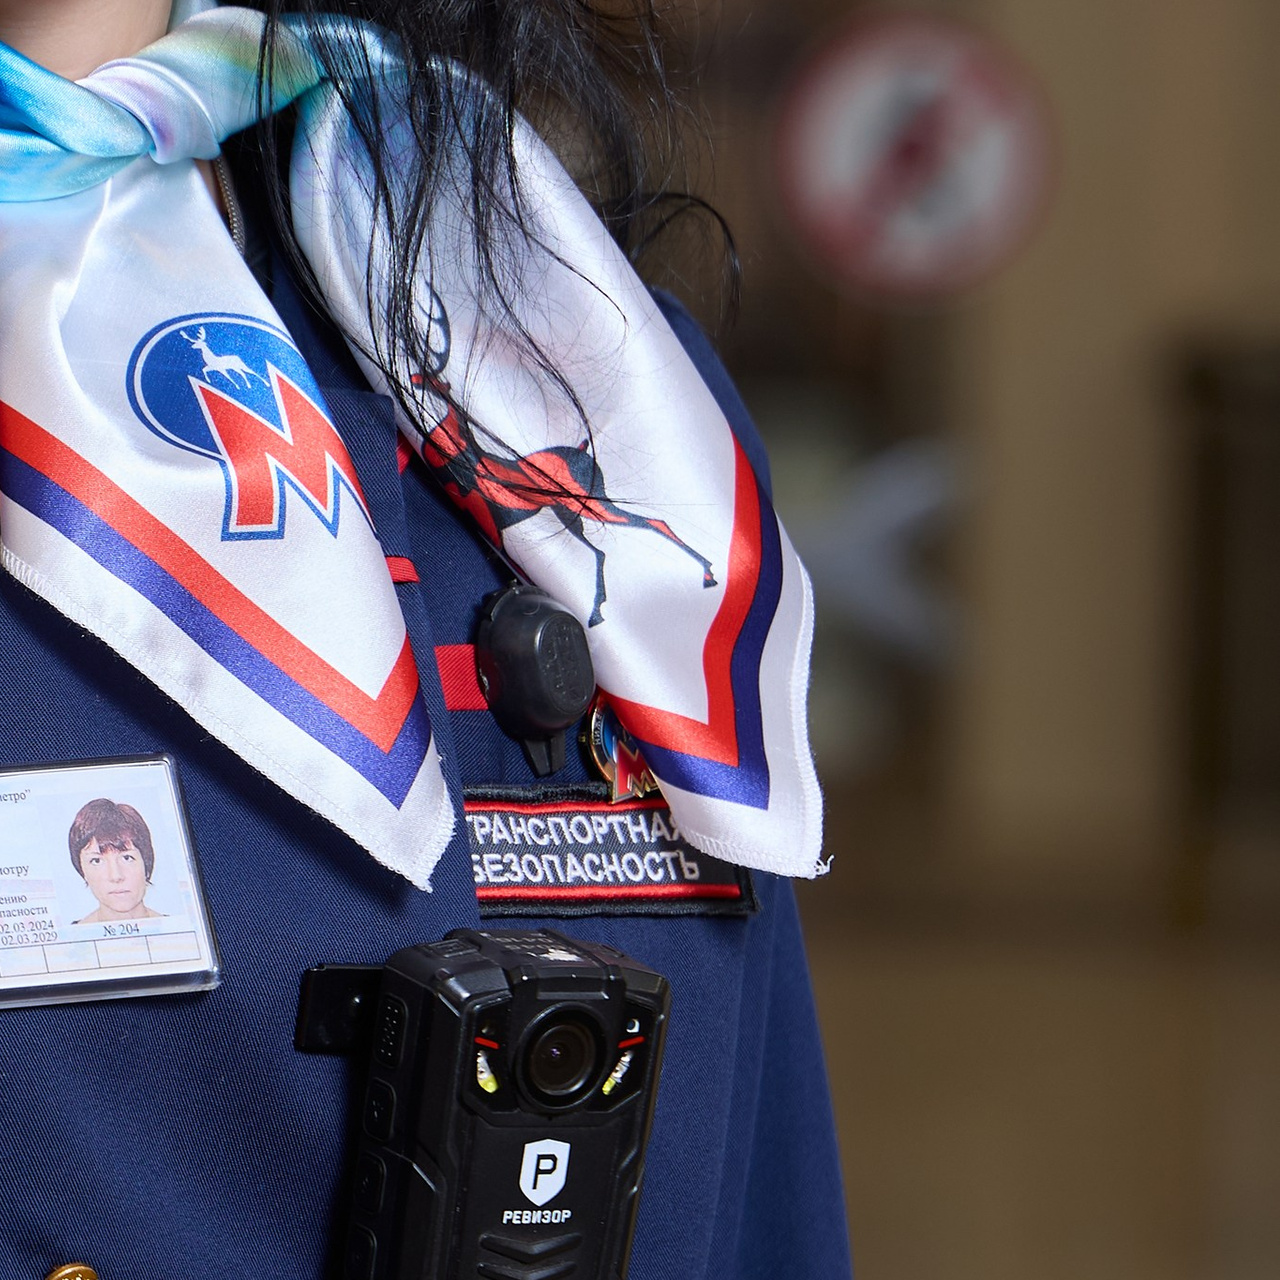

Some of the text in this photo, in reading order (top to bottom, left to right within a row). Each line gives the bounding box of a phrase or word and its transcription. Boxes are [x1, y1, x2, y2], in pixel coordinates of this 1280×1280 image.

[119, 923, 140, 935] 204
[1, 931, 58, 946] 02.03.2029
[532, 1154, 558, 1190] Р
[502, 1209, 572, 1224] РЕВИЗОР
